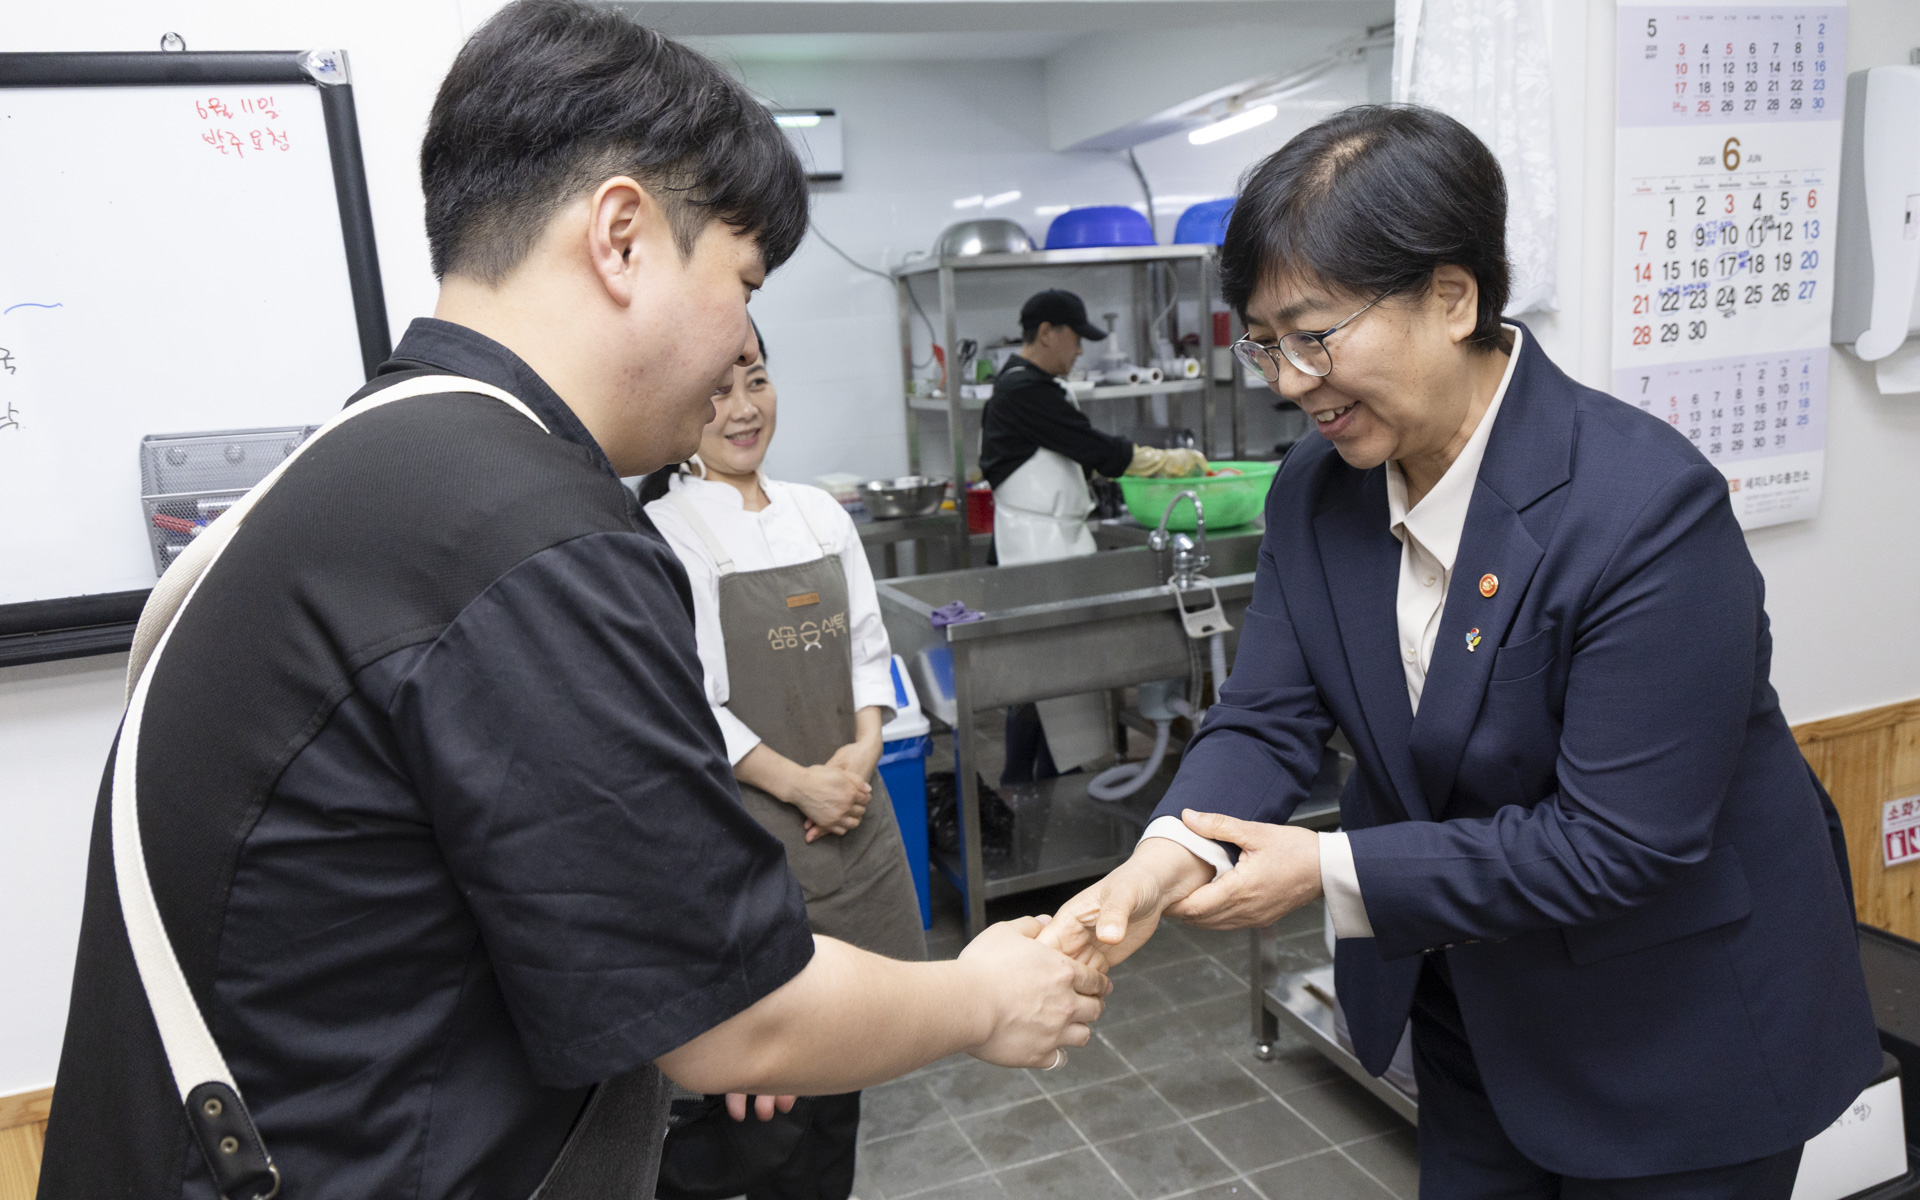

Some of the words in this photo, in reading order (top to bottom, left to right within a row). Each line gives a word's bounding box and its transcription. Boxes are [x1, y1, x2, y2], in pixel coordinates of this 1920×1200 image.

[1647, 18, 1657, 37] 5
[1797, 24, 1801, 34] 1
[1818, 23, 1825, 34] 2
[1679, 43, 1685, 55] 3
[1702, 44, 1709, 54] 4
[1726, 43, 1732, 54] 5
[1749, 43, 1756, 54] 6
[1773, 43, 1779, 53] 7
[1795, 42, 1801, 53] 8
[1817, 42, 1824, 53] 9
[1675, 63, 1688, 75] 10
[1699, 63, 1710, 74] 11
[1723, 63, 1735, 73] 12
[1746, 62, 1758, 73] 13
[1769, 62, 1781, 73] 14
[1792, 61, 1804, 72] 15
[1815, 61, 1826, 72] 16
[1675, 83, 1687, 94] 17
[1699, 82, 1711, 93] 18
[1722, 81, 1734, 92] 19
[1745, 81, 1757, 92] 20
[1768, 80, 1779, 91] 21
[1791, 80, 1803, 91] 22
[1813, 79, 1825, 90] 23
[195, 97, 234, 120] 6월
[240, 96, 280, 120] 11일
[1698, 101, 1710, 112] 25
[1721, 100, 1733, 111] 26
[1744, 100, 1756, 111] 27
[1767, 99, 1779, 110] 28
[1790, 99, 1802, 109] 29
[1812, 98, 1824, 109] 30
[202, 128, 244, 158] 발주
[250, 127, 290, 151] 요청
[1723, 137, 1741, 171] 6
[1669, 198, 1675, 216] 1
[1696, 196, 1706, 215] 2
[1725, 194, 1734, 213] 3
[1753, 193, 1762, 211] 4
[1780, 192, 1789, 210] 5
[1807, 189, 1816, 208] 6
[1639, 232, 1648, 250] 7
[1667, 229, 1676, 249] 8
[1696, 228, 1705, 246] 9
[1721, 226, 1739, 245] 10
[1750, 224, 1764, 243] 11
[1777, 222, 1792, 241] 12
[1803, 220, 1820, 239] 13
[1634, 263, 1651, 283] 14
[1663, 261, 1680, 280] 15
[1692, 259, 1709, 278] 16
[1720, 257, 1736, 276] 17
[1749, 254, 1764, 274] 18
[1775, 253, 1792, 272] 19
[1801, 250, 1819, 270] 20
[1633, 295, 1649, 314] 21
[1662, 292, 1679, 312] 22
[1689, 289, 1707, 309] 23
[1716, 288, 1735, 306] 24
[1745, 285, 1762, 304] 25
[1772, 283, 1790, 302] 26
[1798, 281, 1816, 300] 27
[1633, 326, 1651, 345] 28
[1661, 323, 1679, 343] 29
[1688, 320, 1707, 340] 30
[1641, 376, 1650, 394] 7
[1737, 372, 1742, 382] 1
[1758, 369, 1765, 380] 2
[1780, 367, 1787, 377] 3
[1802, 365, 1809, 374] 4
[1670, 396, 1677, 407] 5
[1692, 394, 1699, 405] 6
[1714, 392, 1720, 402] 7
[1736, 389, 1742, 399] 8
[1758, 386, 1764, 397] 9
[1778, 384, 1789, 394] 10
[1799, 382, 1810, 392] 11
[1690, 411, 1700, 422] 13
[1711, 409, 1723, 419] 14
[1733, 406, 1744, 417] 15
[1755, 403, 1766, 414] 16
[1777, 401, 1788, 411] 17
[1799, 398, 1810, 408] 18
[1689, 429, 1701, 439] 20
[1710, 426, 1721, 437] 21
[1732, 423, 1744, 434] 22
[1754, 420, 1766, 431] 23
[1775, 418, 1787, 428] 24
[1797, 415, 1809, 425] 25
[1710, 443, 1722, 454] 28
[1731, 440, 1743, 451] 29
[1753, 437, 1765, 448] 30
[1775, 434, 1786, 445] 31
